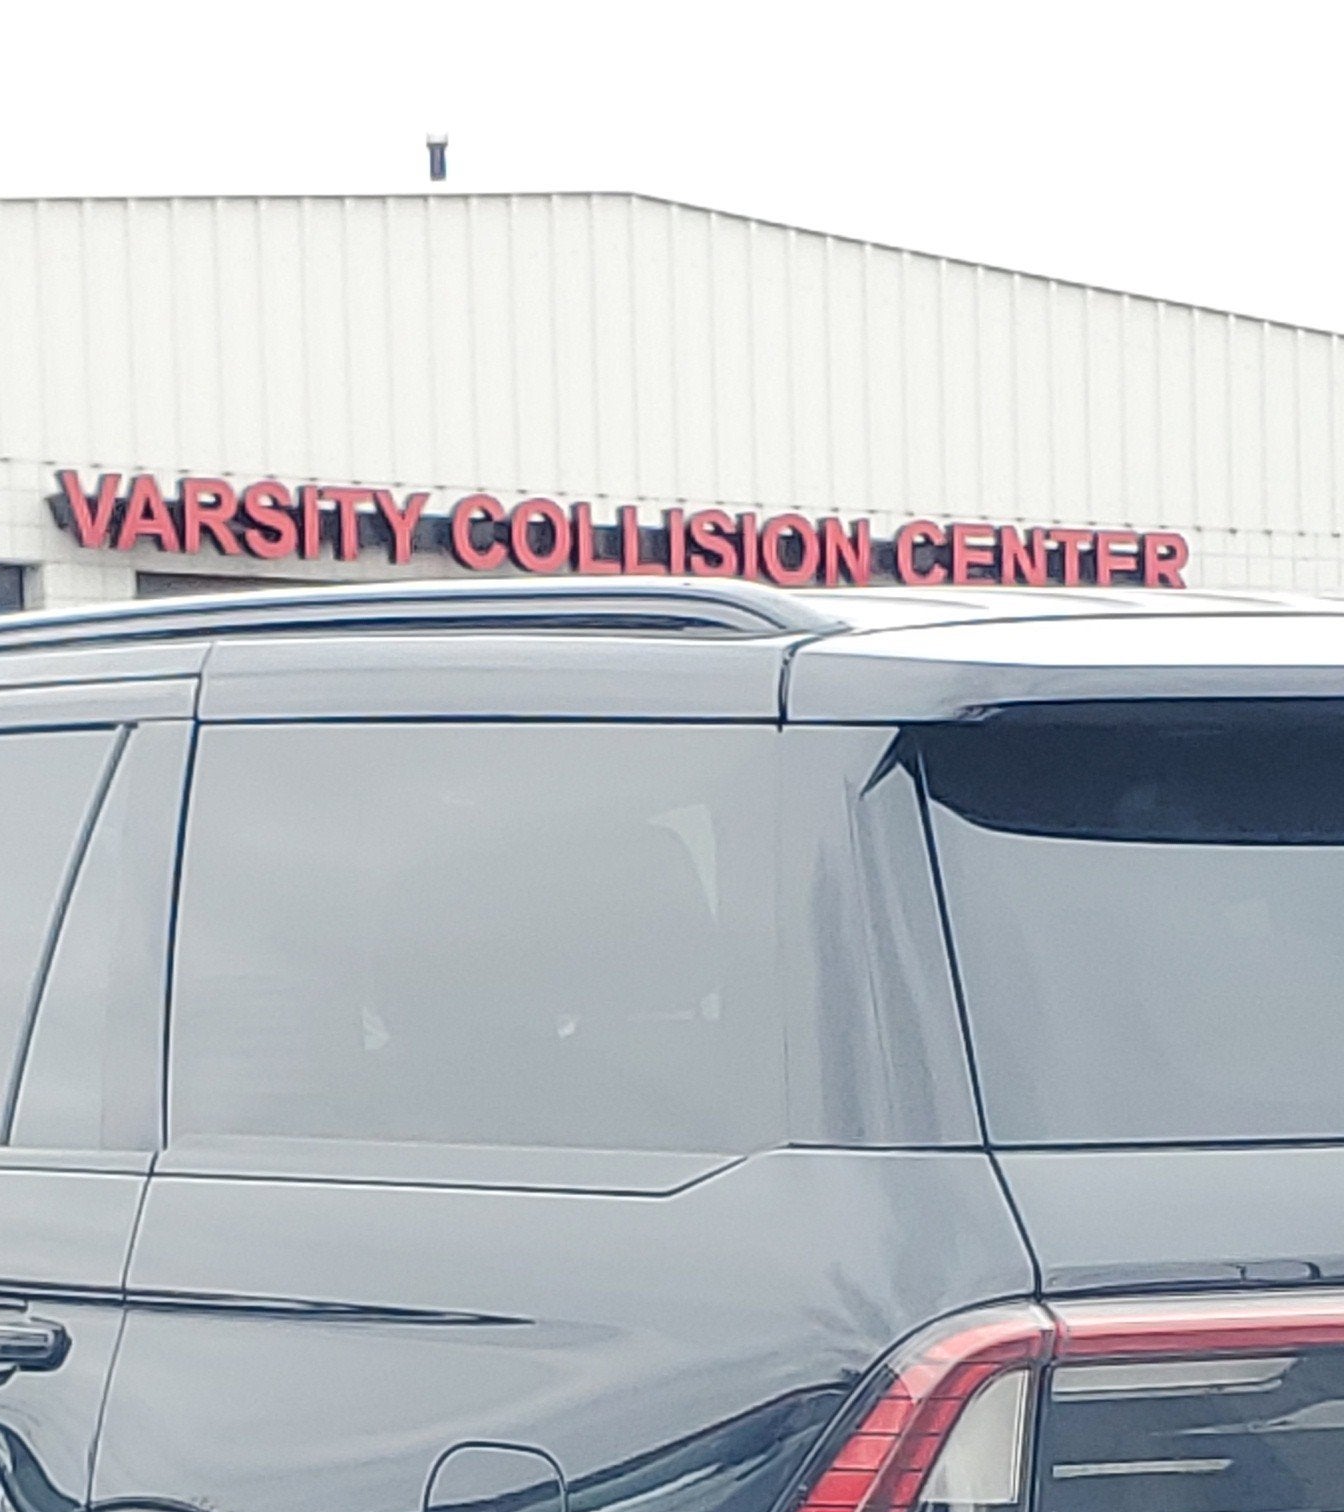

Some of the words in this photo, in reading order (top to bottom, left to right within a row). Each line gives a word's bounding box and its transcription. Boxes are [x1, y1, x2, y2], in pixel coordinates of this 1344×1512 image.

[55, 470, 431, 566] VARSITY
[451, 493, 870, 587] COLLISION
[895, 519, 1189, 589] CENTER
